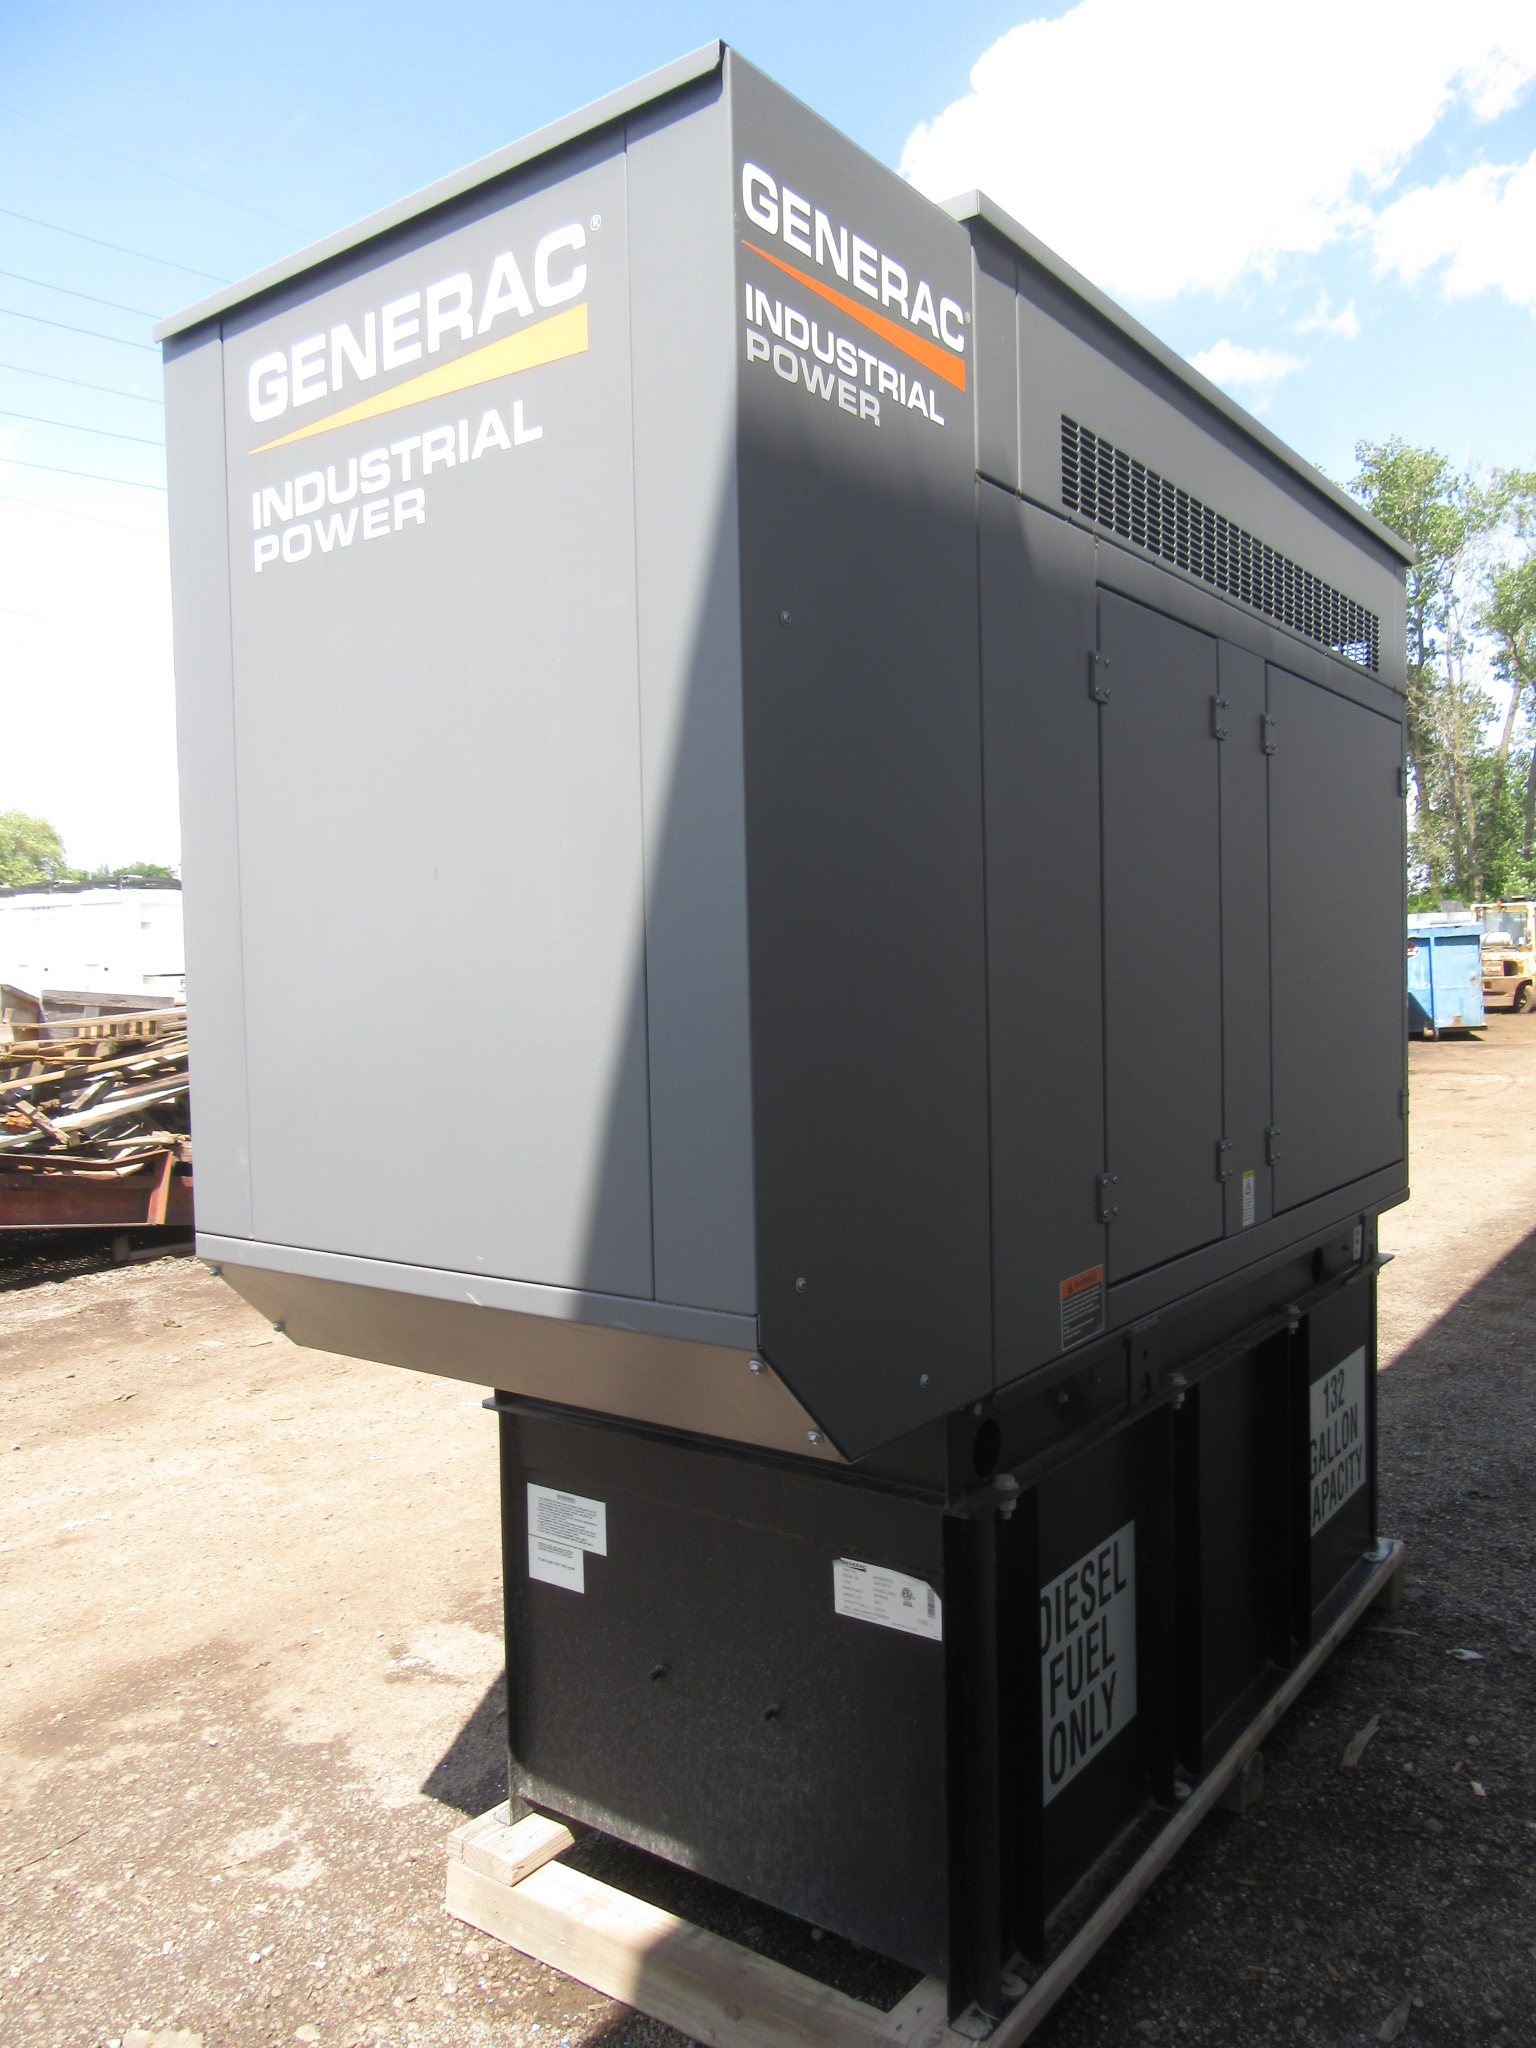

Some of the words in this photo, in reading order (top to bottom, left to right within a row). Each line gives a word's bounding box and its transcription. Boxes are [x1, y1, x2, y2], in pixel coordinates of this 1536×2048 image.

[743, 163, 964, 352] GENERAC
[746, 283, 945, 426] INDUSTRIAL
[747, 328, 881, 427] POWER
[253, 400, 543, 531] INDUSTRIAL
[253, 488, 426, 573] POWER
[1310, 1403, 1358, 1481] GALLON
[1322, 1368, 1345, 1418] 132
[1311, 1443, 1363, 1528] APACITY
[1040, 1540, 1127, 1656] DIESEL
[1050, 1615, 1116, 1719] FUEL
[1050, 1670, 1117, 1786] ONLY
